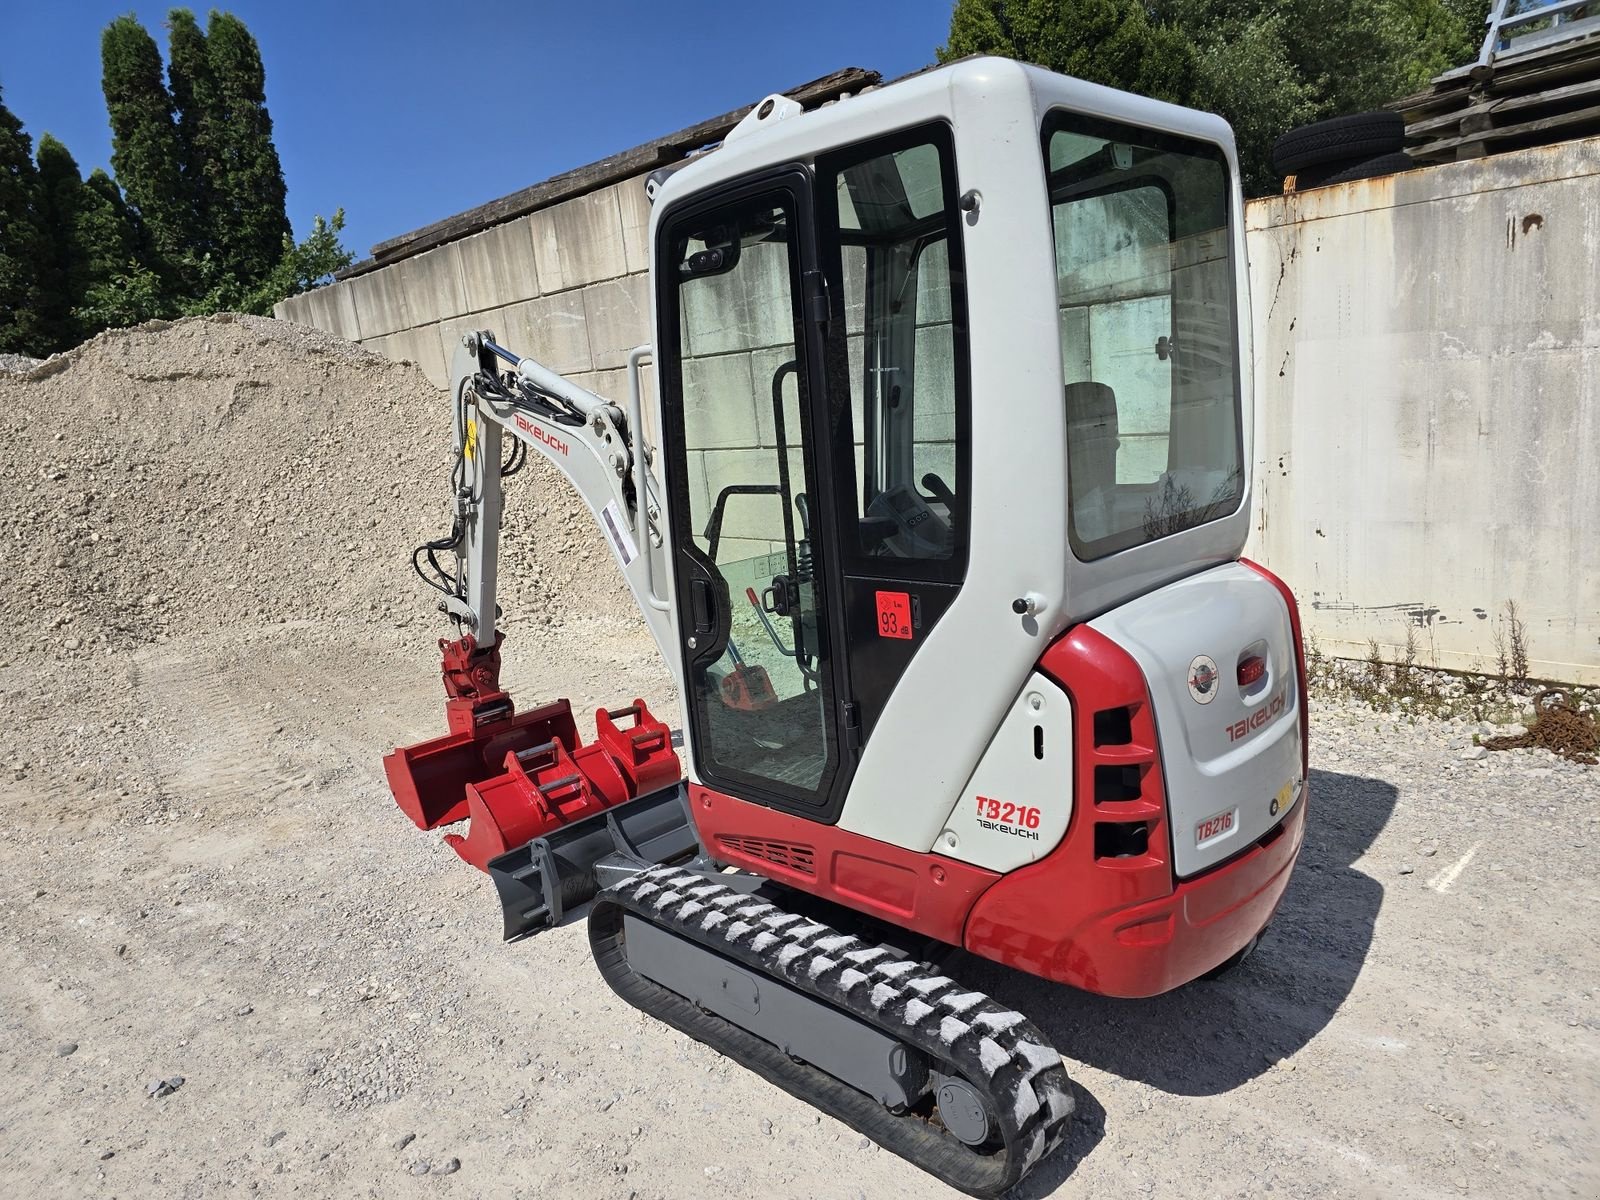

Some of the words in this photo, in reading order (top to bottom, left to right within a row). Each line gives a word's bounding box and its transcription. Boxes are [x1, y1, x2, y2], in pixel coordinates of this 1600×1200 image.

[882, 611, 898, 633] 93
[975, 796, 1041, 829] TB216
[1197, 812, 1232, 841] TB216
